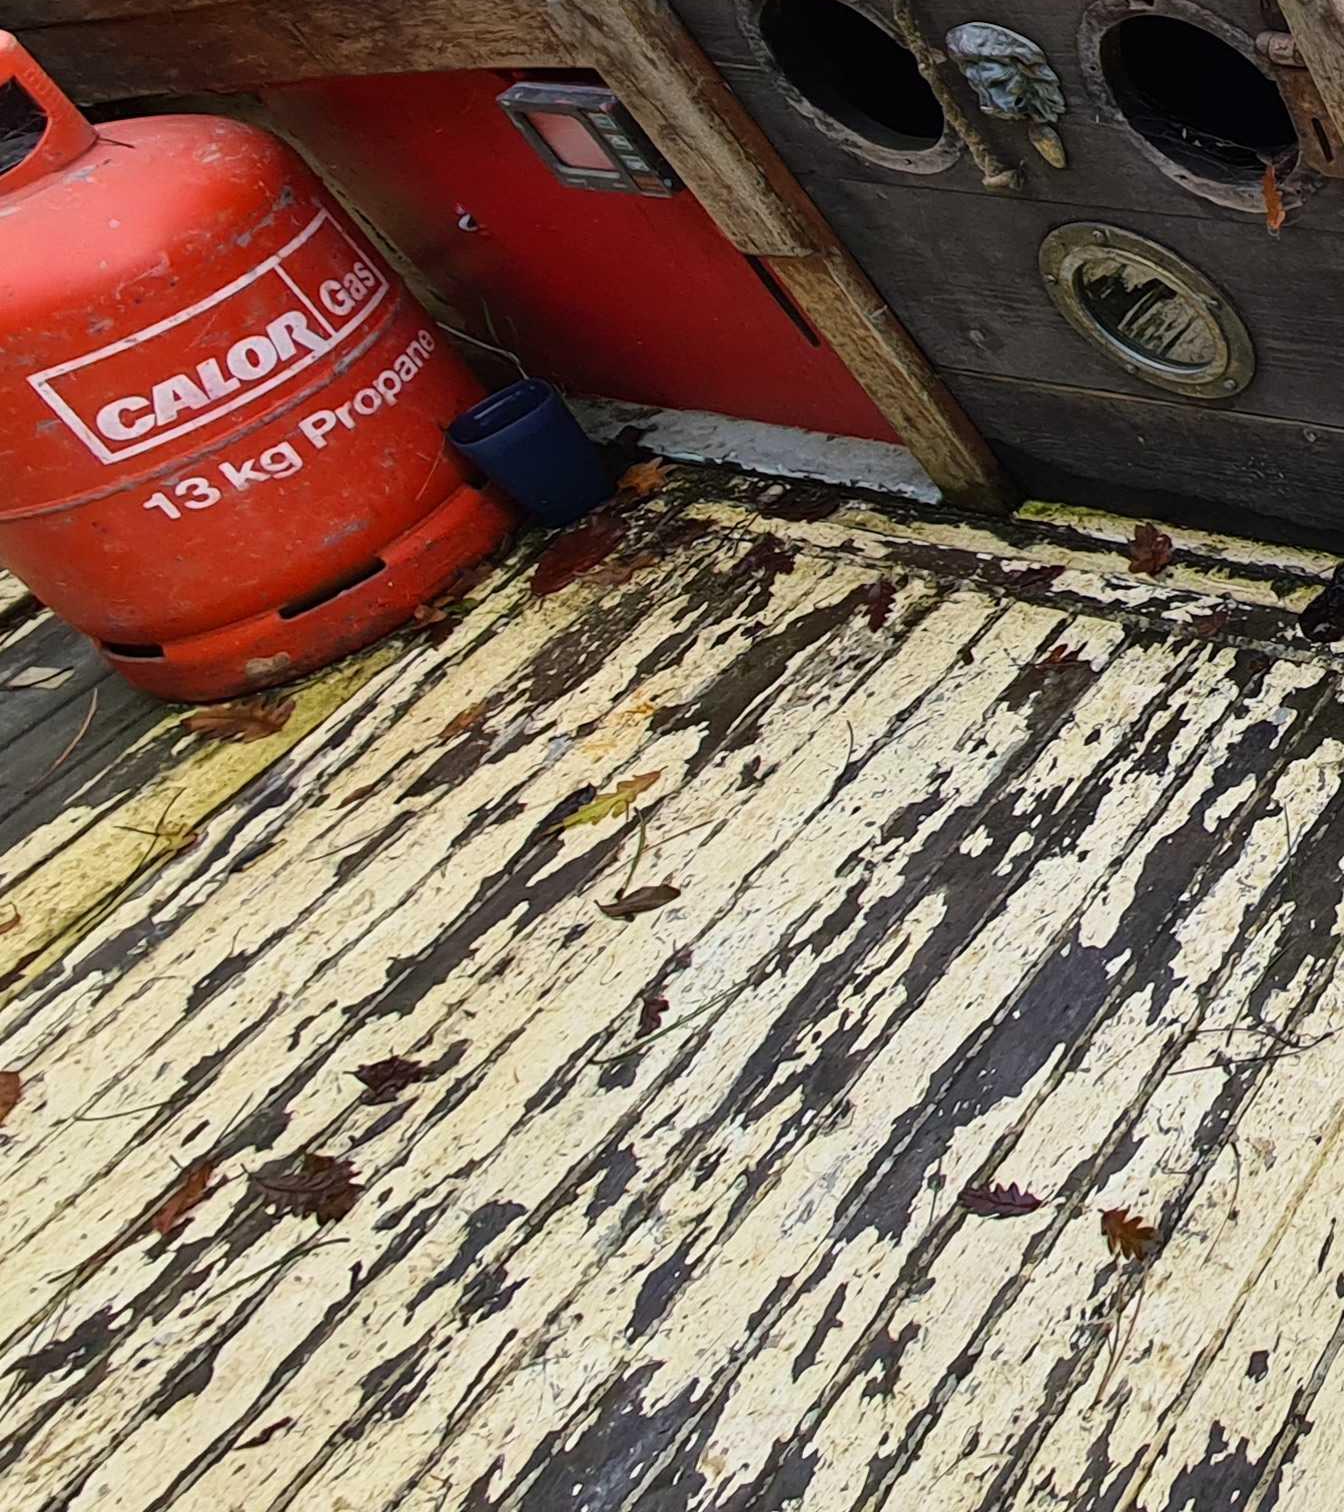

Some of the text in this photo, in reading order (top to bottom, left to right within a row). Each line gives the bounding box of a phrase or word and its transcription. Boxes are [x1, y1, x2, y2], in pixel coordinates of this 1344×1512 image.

[96, 261, 377, 441] CALOR Gas
[142, 328, 437, 520] 13 kg Propane
